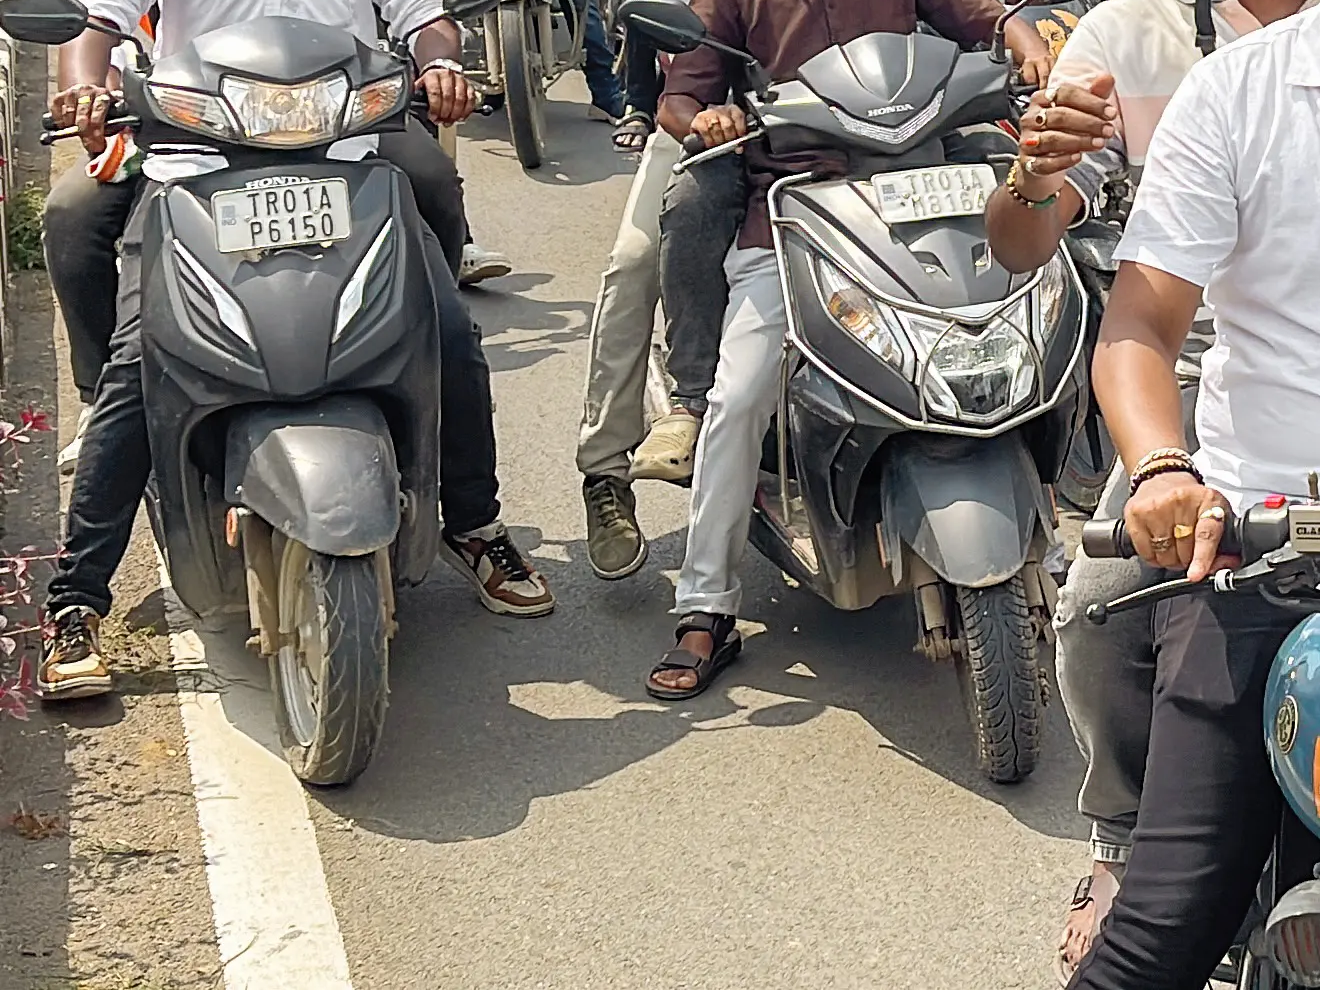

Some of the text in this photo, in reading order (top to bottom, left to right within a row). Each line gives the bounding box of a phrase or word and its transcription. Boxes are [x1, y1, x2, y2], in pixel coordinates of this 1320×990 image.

[868, 104, 914, 117] HONDA
[246, 185, 332, 217] TR01A
[250, 213, 334, 247] P6150
